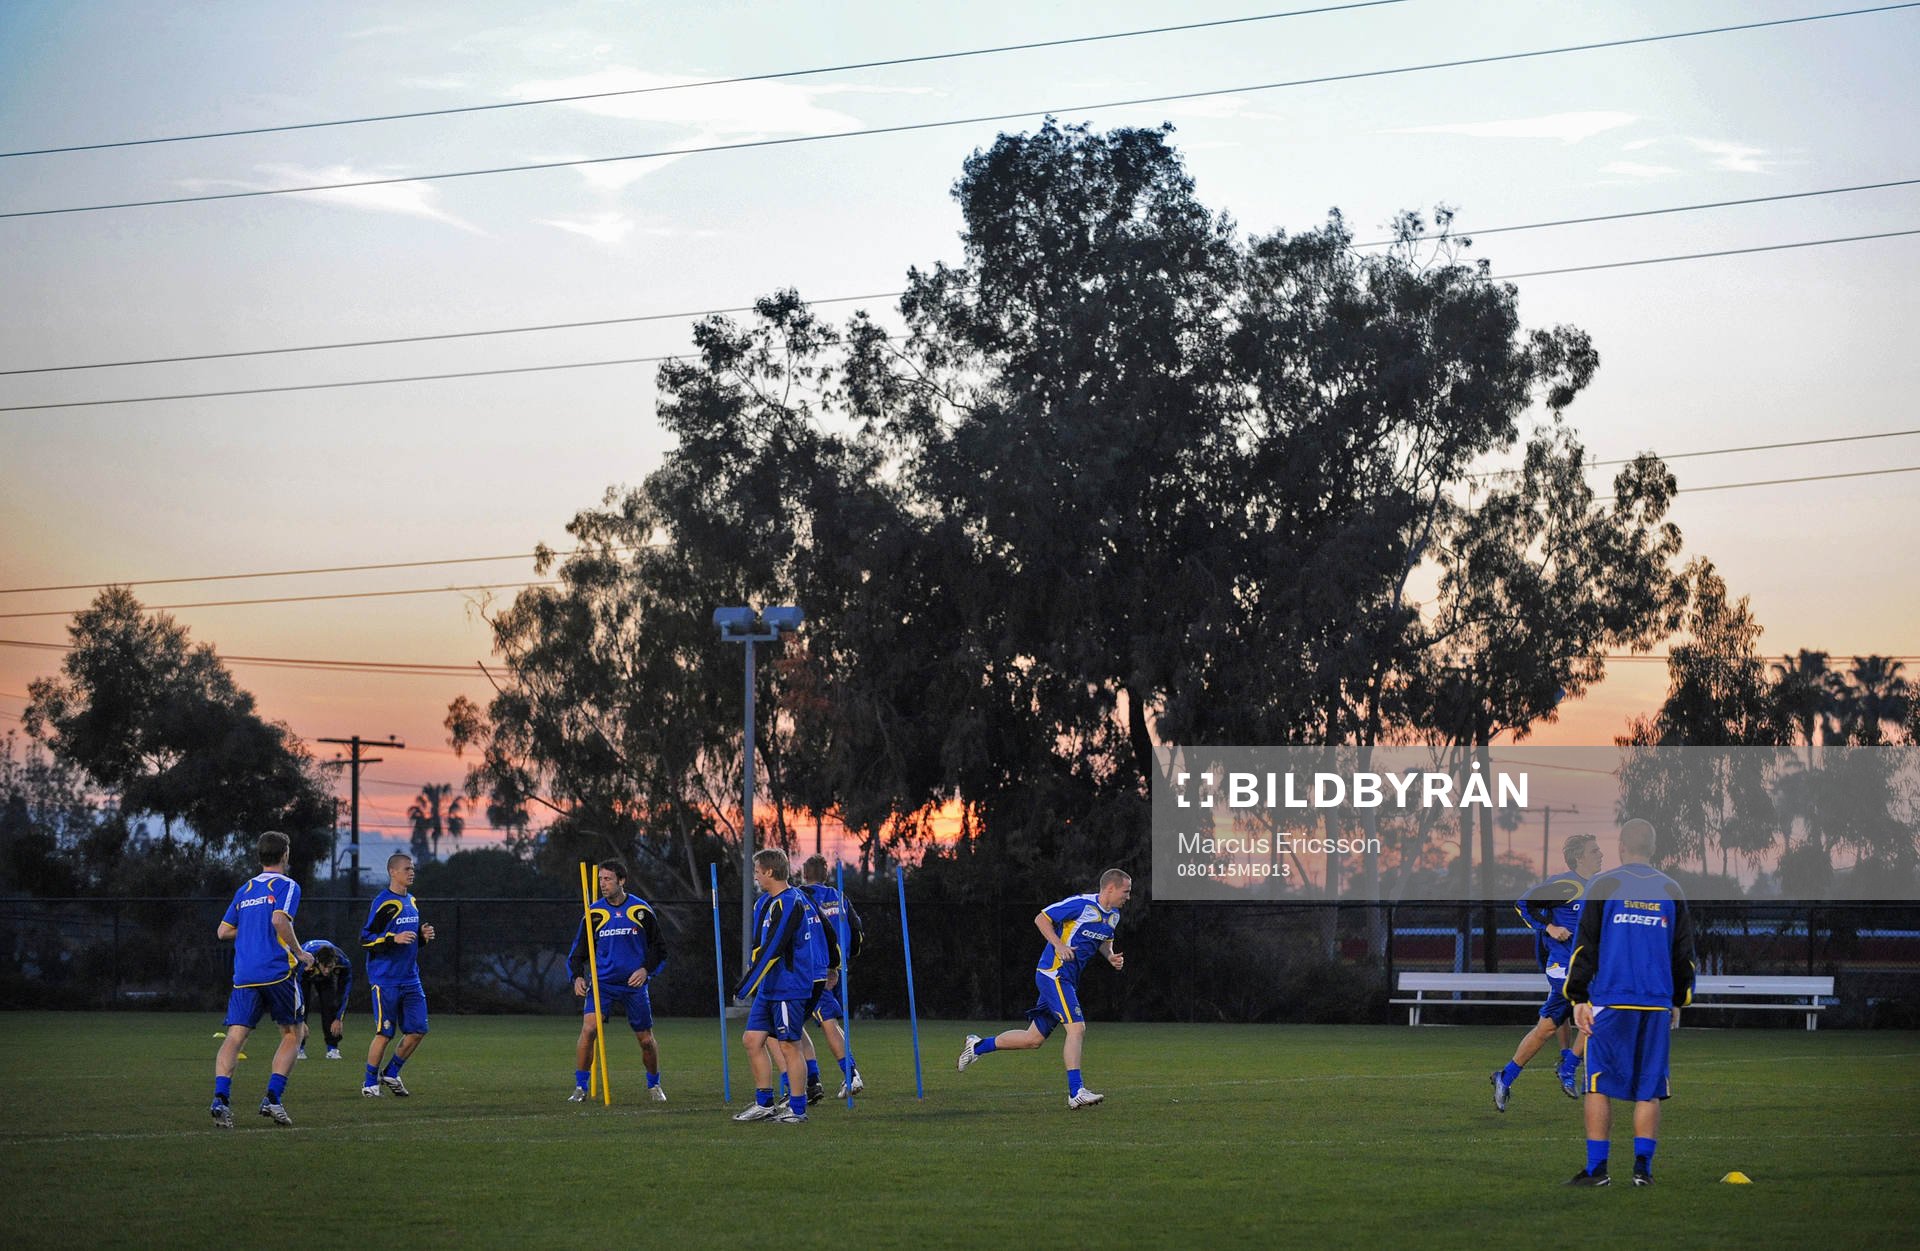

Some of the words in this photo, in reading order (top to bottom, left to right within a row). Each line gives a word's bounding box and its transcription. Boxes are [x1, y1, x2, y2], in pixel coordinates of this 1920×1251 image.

[240, 896, 268, 908] ODDSET
[1624, 900, 1661, 911] SVERIGE
[1613, 914, 1661, 926] ODDSET
[599, 928, 632, 937] ODDSET
